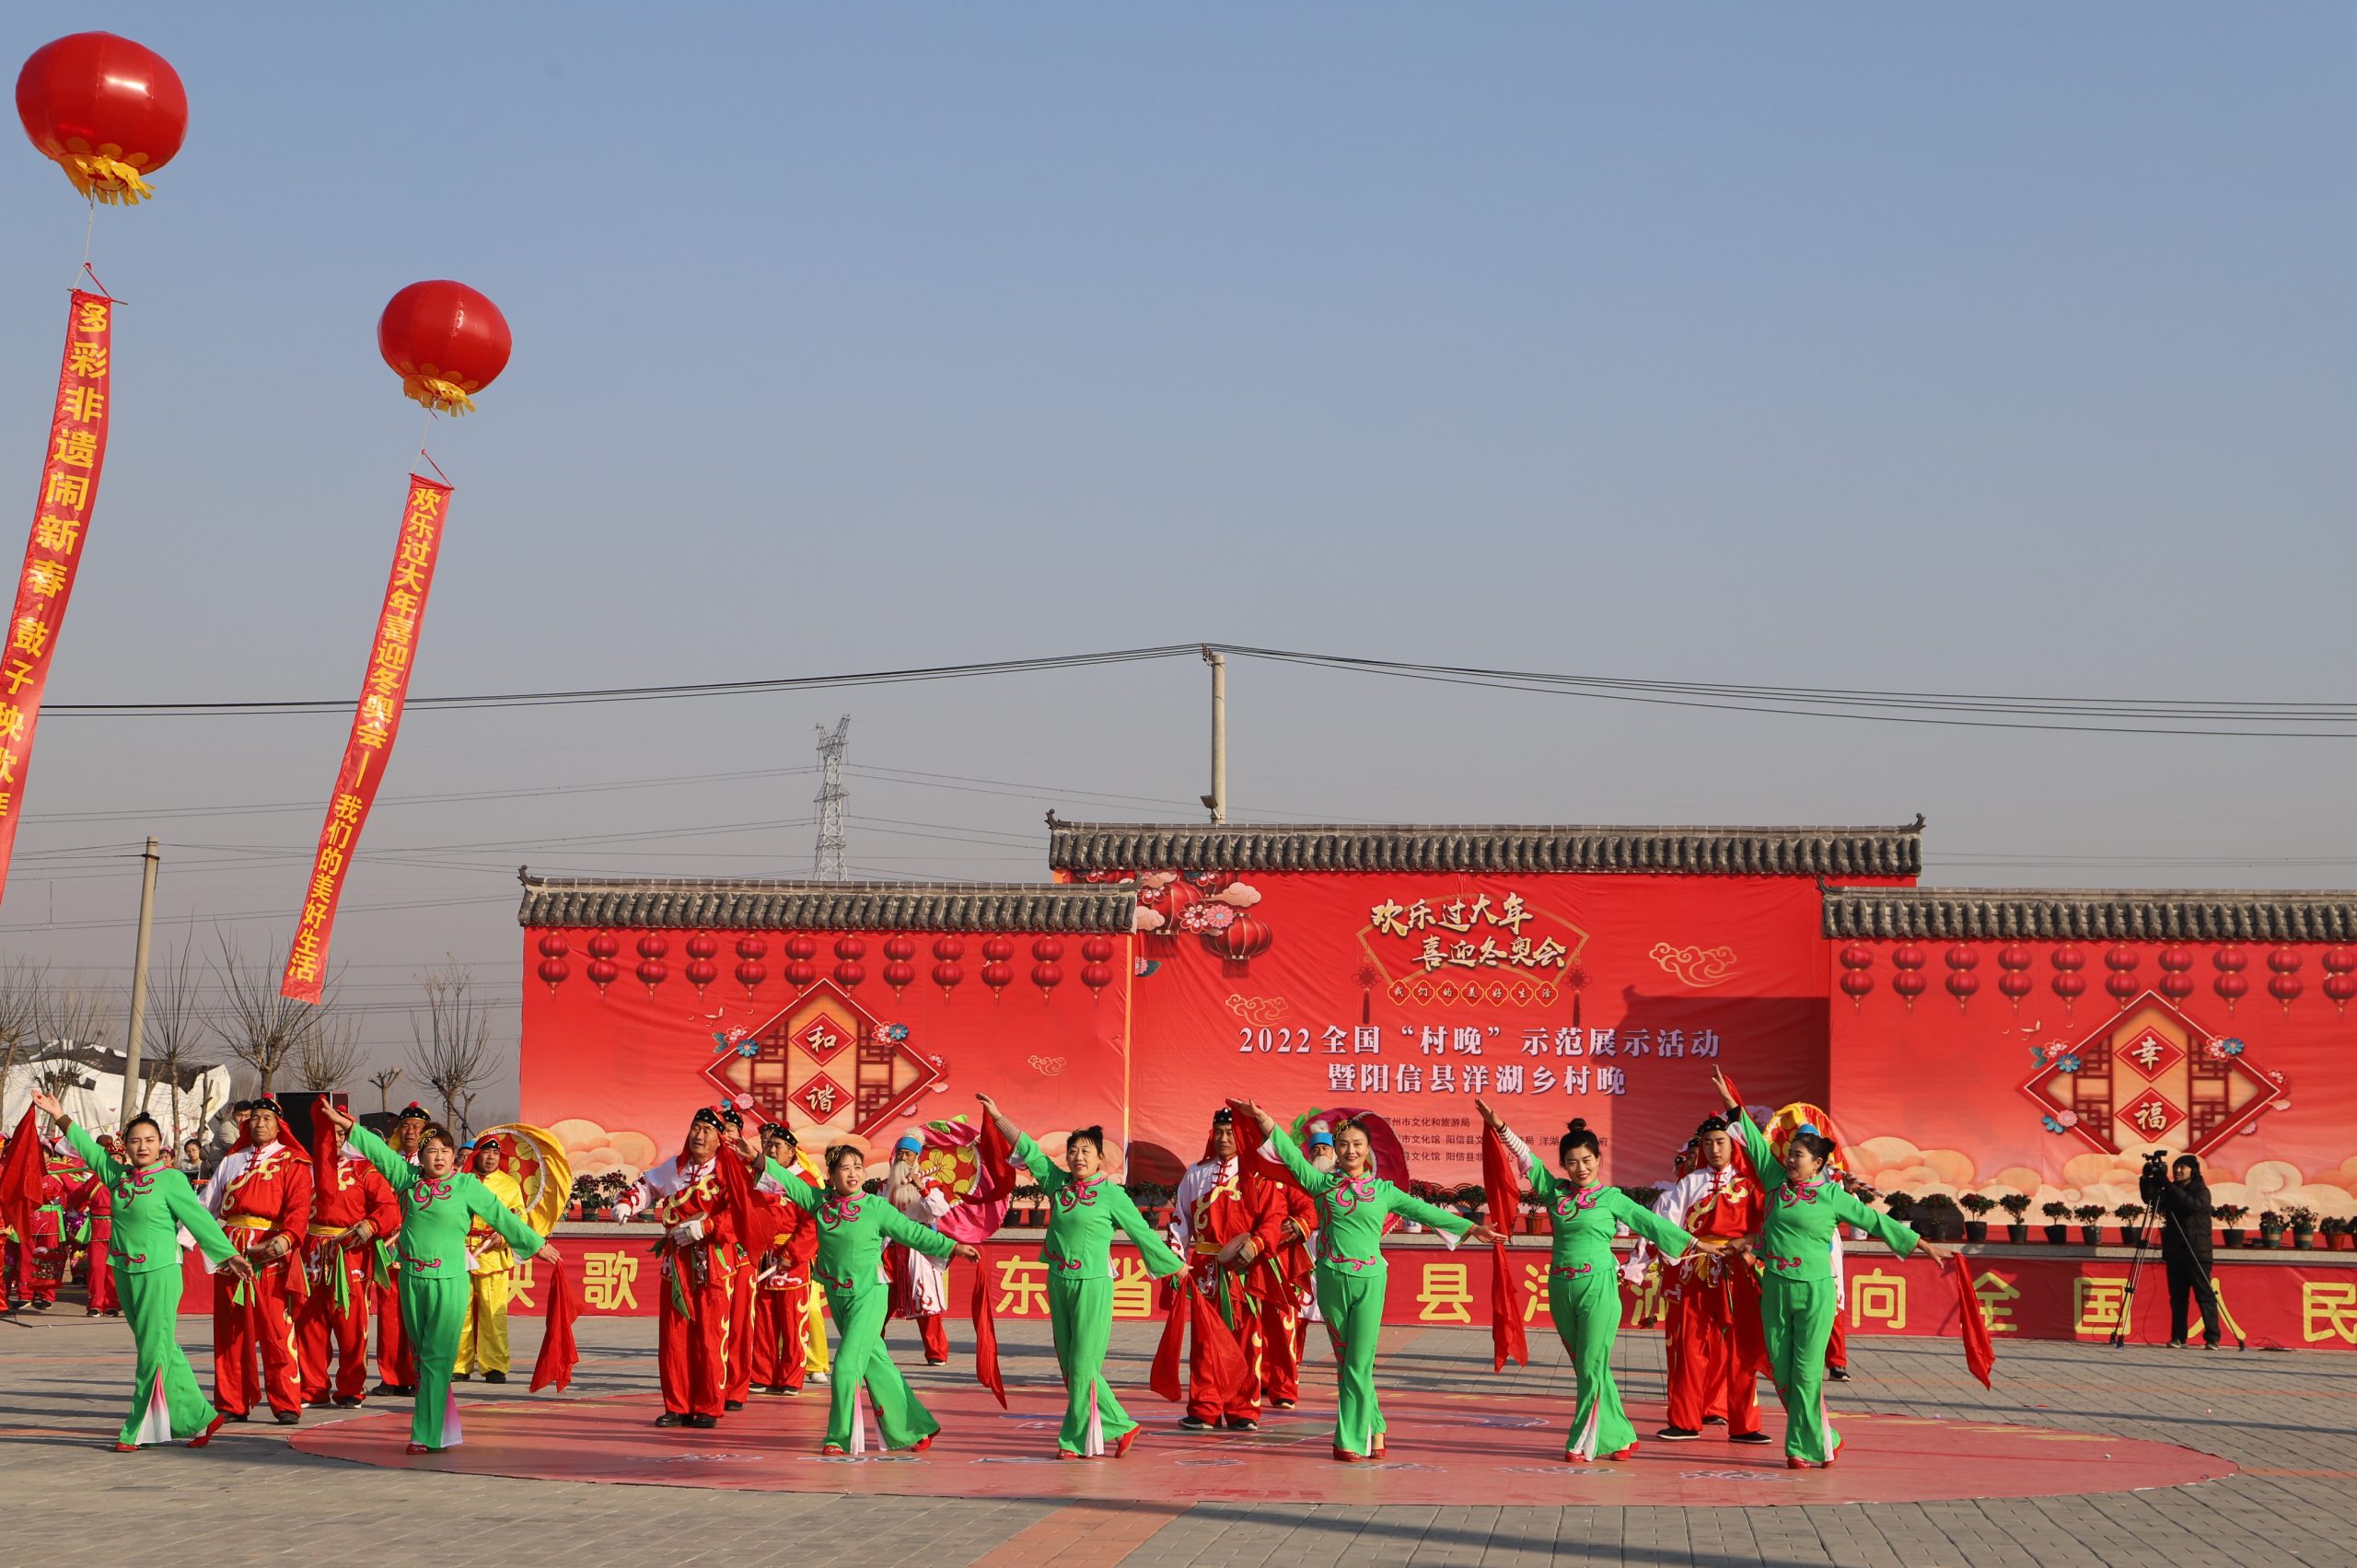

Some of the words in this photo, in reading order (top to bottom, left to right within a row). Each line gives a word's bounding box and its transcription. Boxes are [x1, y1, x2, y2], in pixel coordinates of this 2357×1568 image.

[1371, 891, 1534, 936] 欢乐过大年
[1412, 934, 1567, 972] 喜迎冬奥会
[1394, 985, 1551, 999] 我们的美好生活
[806, 1025, 837, 1112] 和谐
[1328, 1063, 1627, 1095] 暨阳信县洋湖乡村晚
[2131, 1036, 2167, 1131] 幸福
[1399, 1135, 1441, 1144] 市文化馆
